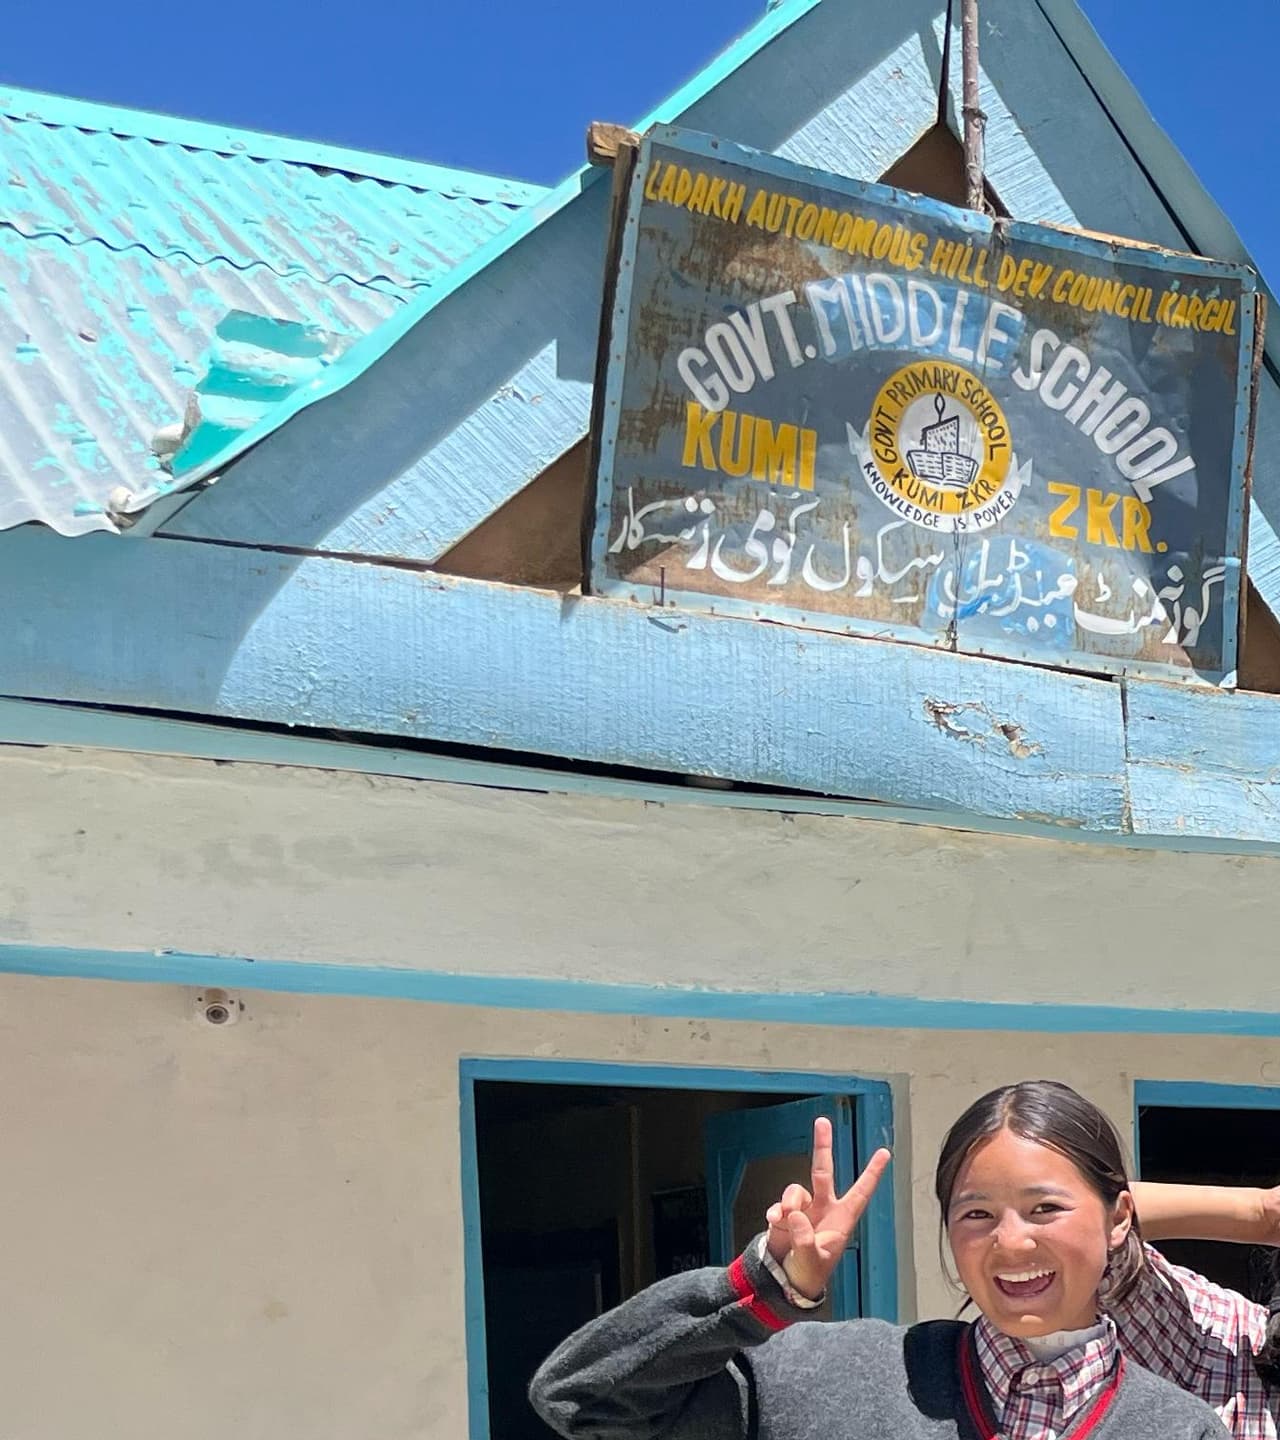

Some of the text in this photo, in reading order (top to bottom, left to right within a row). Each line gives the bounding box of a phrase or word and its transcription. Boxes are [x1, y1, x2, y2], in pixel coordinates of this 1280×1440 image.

[645, 160, 746, 224] LADAKH
[746, 190, 928, 271] AUTONOMOUS
[930, 238, 989, 288] HILL
[1052, 269, 1153, 324] COUNCIL
[1156, 291, 1237, 336] KARGIL
[677, 271, 1196, 503] GOVT. MIDDLE SCHOOL
[886, 366, 960, 408] PRIMARY
[961, 378, 1007, 462] SCHOOL
[682, 401, 818, 492] KUMI
[891, 467, 945, 510] KUMI
[863, 462, 1017, 530] KNOWLEDGE IS POWER
[1047, 480, 1168, 554] ZKR.
